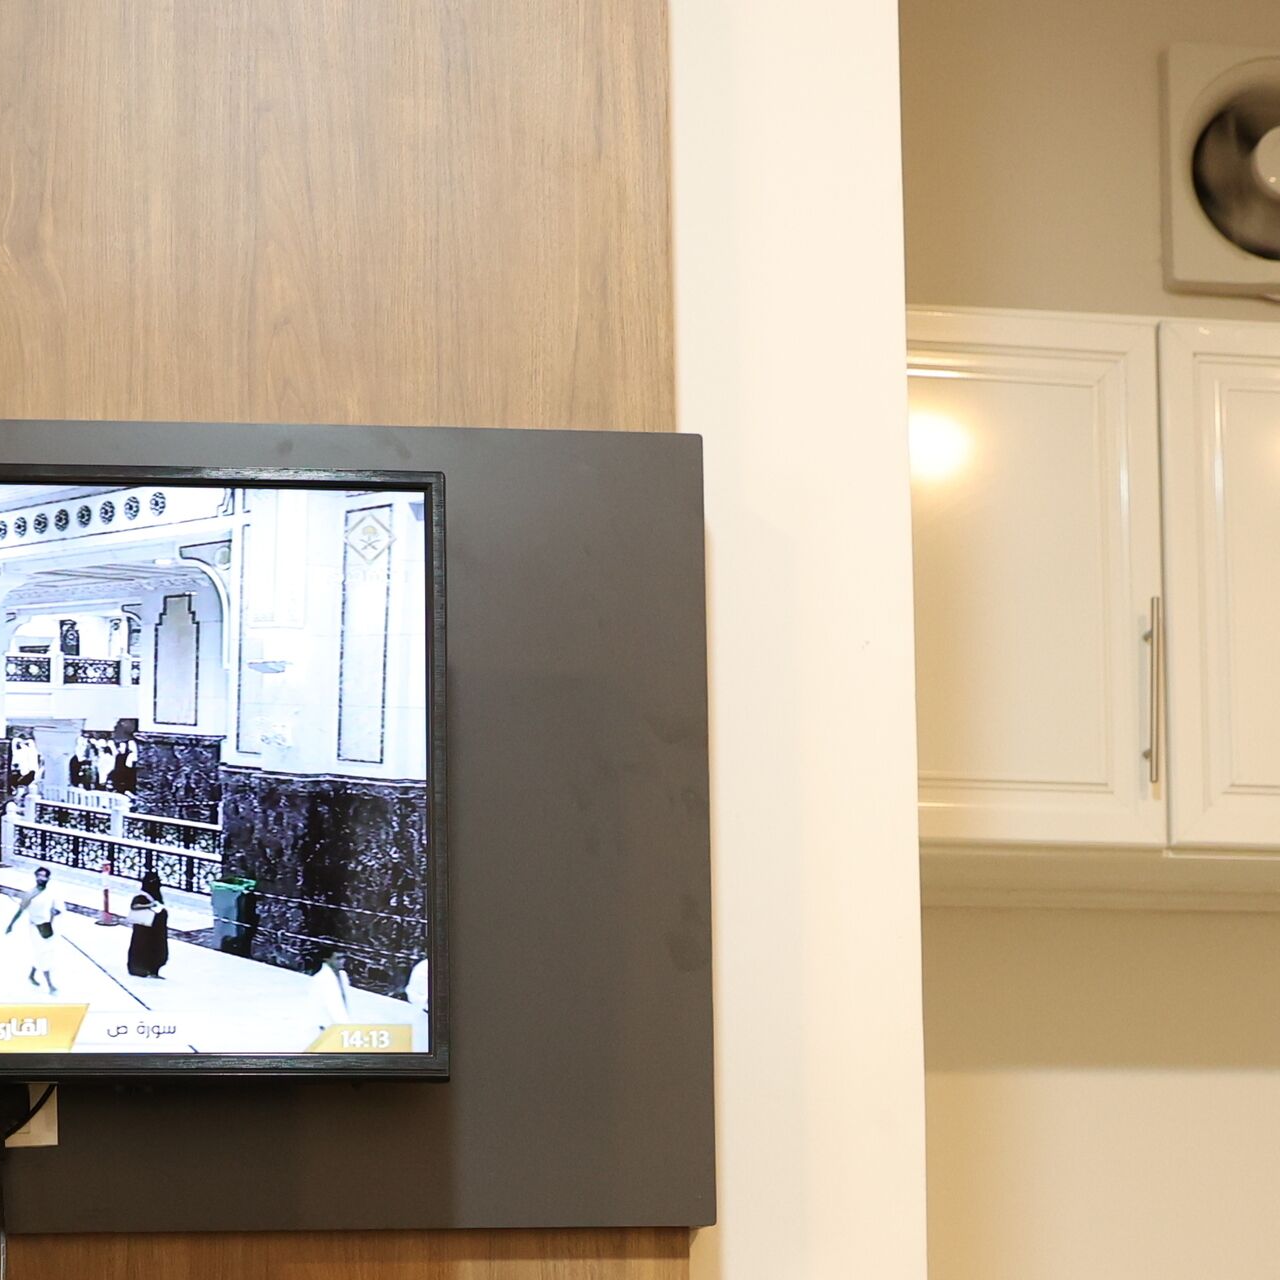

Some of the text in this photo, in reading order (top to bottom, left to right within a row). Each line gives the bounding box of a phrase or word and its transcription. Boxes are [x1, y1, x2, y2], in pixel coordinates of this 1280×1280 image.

[106, 1021, 177, 1039] سورة ص
[340, 1030, 390, 1048] 14:13
